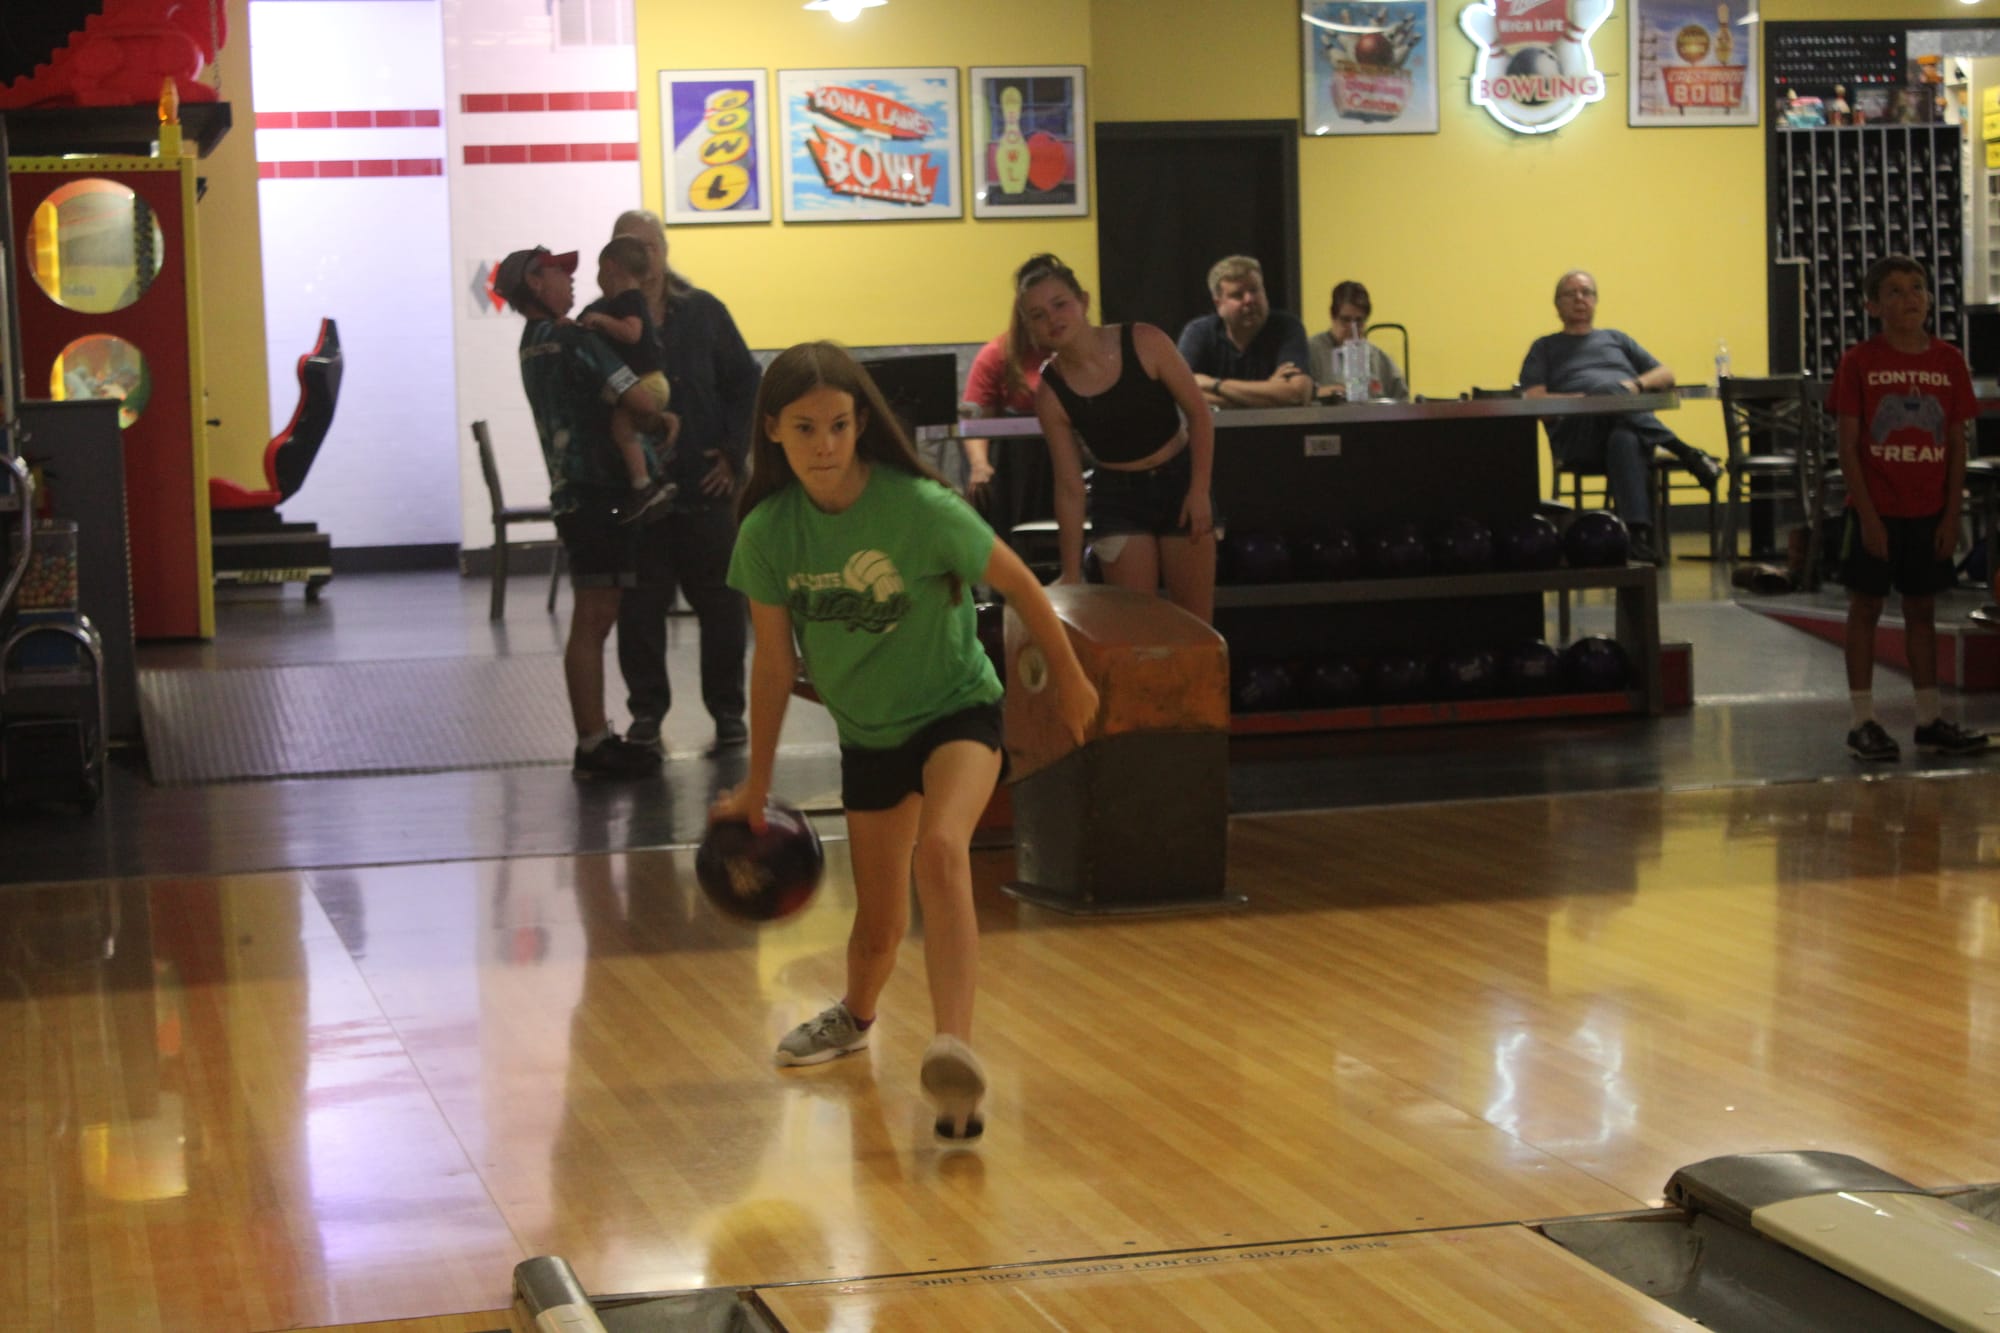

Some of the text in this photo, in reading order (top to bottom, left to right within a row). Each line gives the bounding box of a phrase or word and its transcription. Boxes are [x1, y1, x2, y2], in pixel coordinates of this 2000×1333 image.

[1500, 18, 1564, 32] HIGH LIFE
[1480, 76, 1598, 99] BOWLING
[1674, 84, 1739, 103] BOWL
[823, 138, 932, 195] BOWL
[1868, 371, 1952, 386] CONTROL
[1239, 1246, 1333, 1259] HAZARD
[1043, 1264, 1124, 1276] CROSS
[1133, 1260, 1178, 1268] NOT
[914, 1276, 968, 1287] LINE
[980, 1272, 1036, 1281] FOUL
